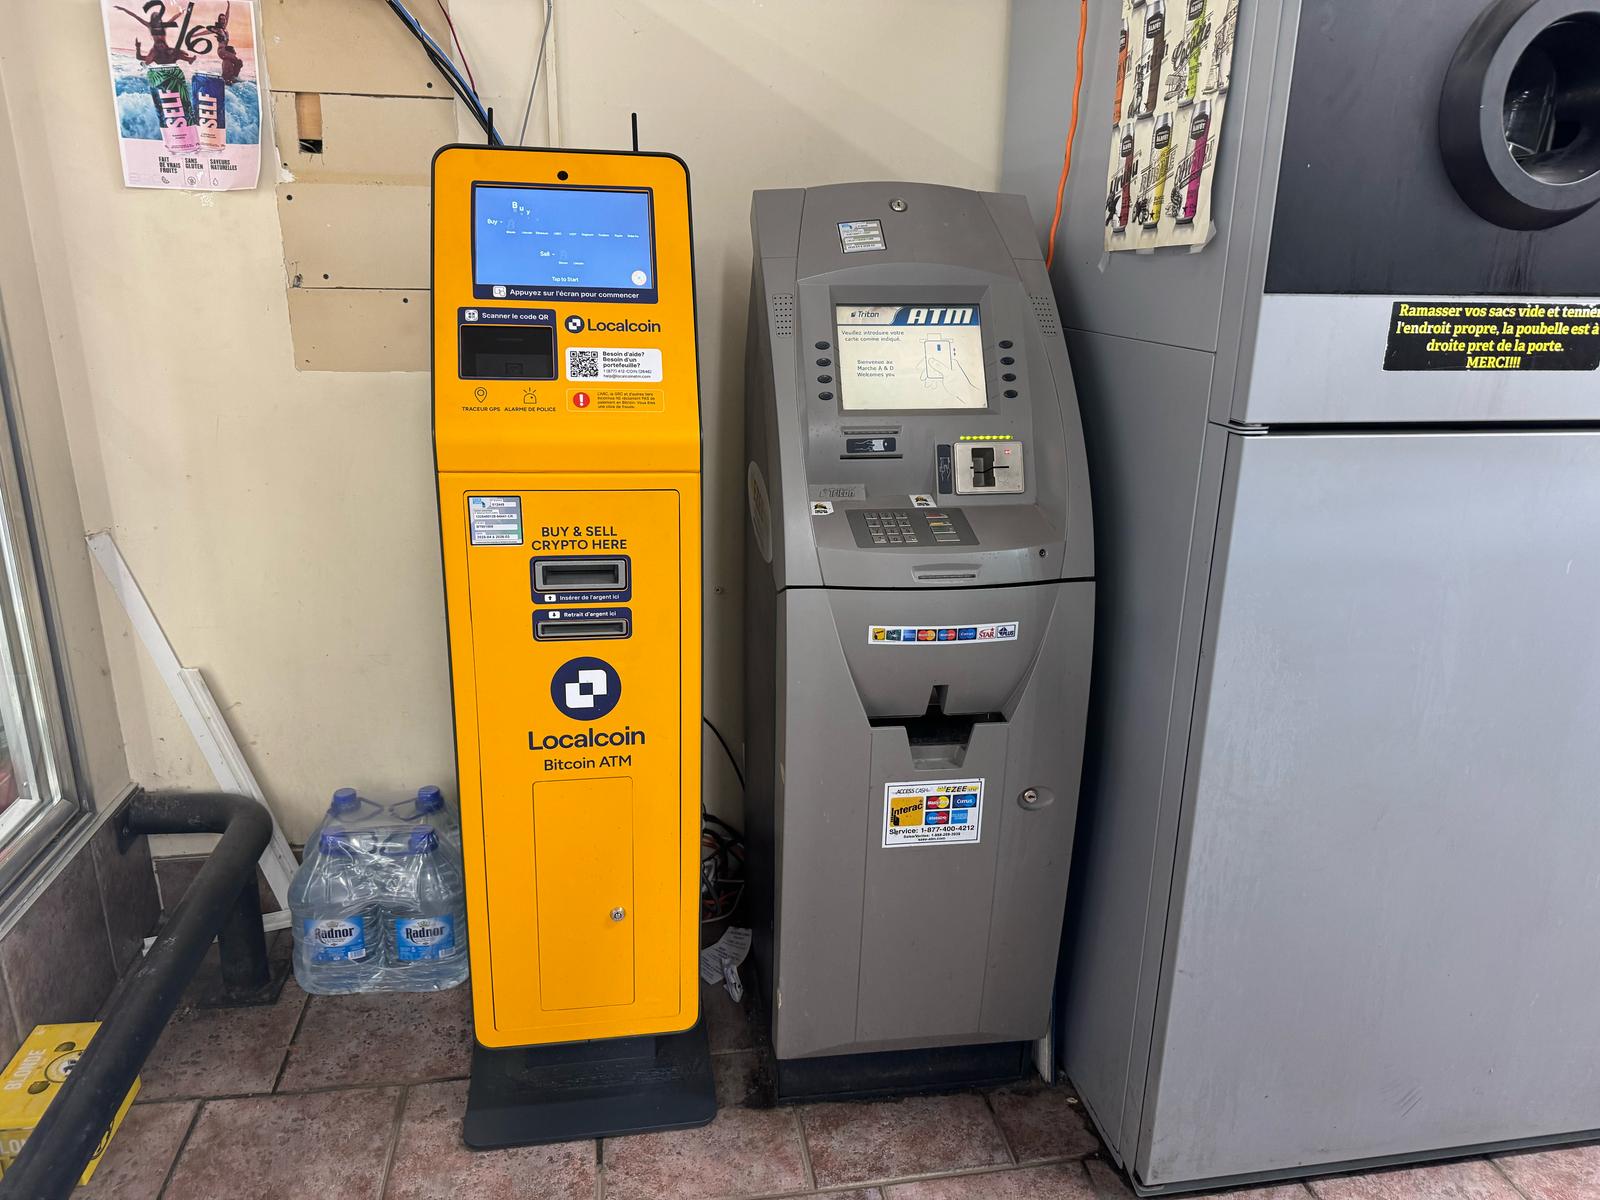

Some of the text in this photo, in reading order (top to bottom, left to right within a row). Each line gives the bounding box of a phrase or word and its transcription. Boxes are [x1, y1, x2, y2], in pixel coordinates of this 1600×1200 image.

[158, 89, 187, 128] SELF
[198, 91, 218, 128] SELF
[510, 289, 542, 298] Appuyez
[555, 289, 580, 297] l'écran
[906, 308, 973, 324] ATM
[1399, 304, 1463, 317] Ramasser
[1464, 307, 1487, 317] vos
[1489, 307, 1515, 317] sacs
[1518, 304, 1545, 318] vide
[1547, 306, 1559, 318] et
[588, 319, 661, 332] Localcoin
[1396, 321, 1600, 337] l'endroit propre, la poubelle est à
[1427, 338, 1564, 354] droite pret de la porte.
[1466, 356, 1521, 368] MERCI!!!
[542, 526, 617, 537] BUY & SELL
[531, 539, 627, 550] CRYPTO HERE
[979, 630, 994, 638] STAR
[528, 726, 646, 750] Localcoin
[544, 755, 632, 771] Bitcoin ATM
[892, 804, 923, 816] Interac
[921, 825, 975, 833] 1-877-400-4212
[315, 927, 354, 940] Radnor
[405, 926, 445, 940] Radnor
